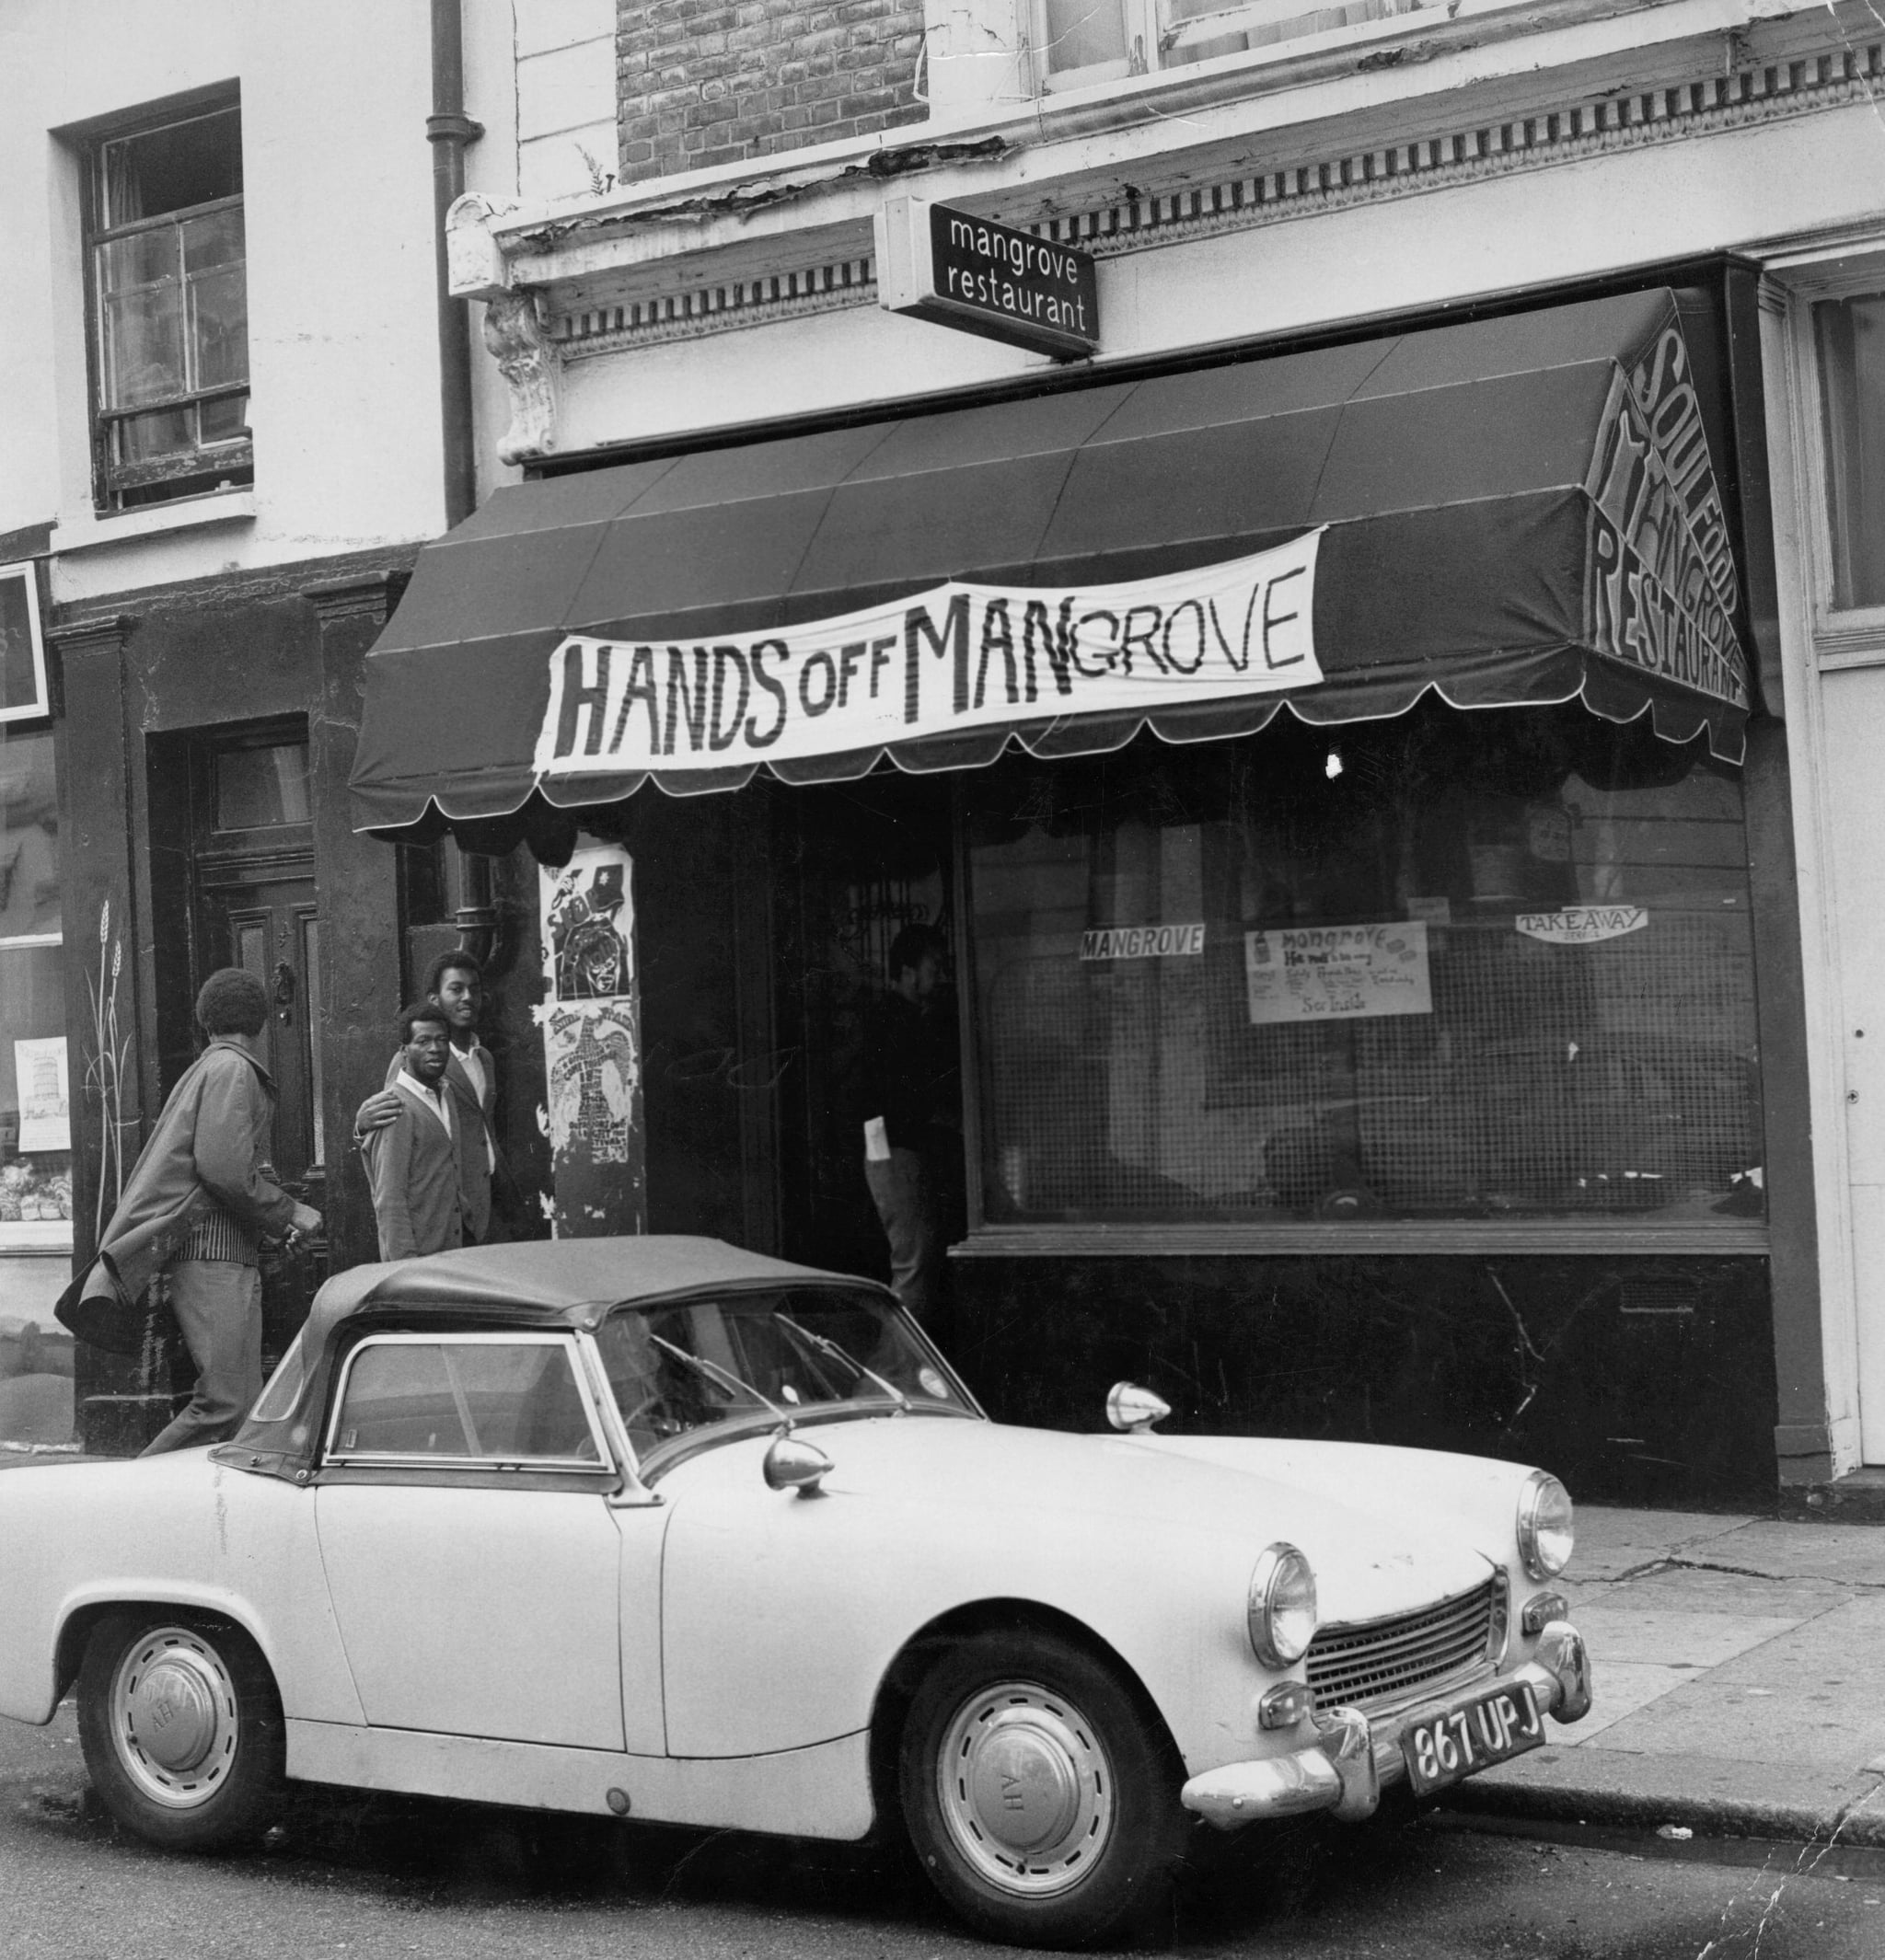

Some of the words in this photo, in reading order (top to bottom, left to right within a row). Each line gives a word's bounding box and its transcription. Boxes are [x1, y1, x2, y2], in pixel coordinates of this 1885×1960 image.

[950, 218, 1078, 283] mangrove
[947, 265, 1087, 331] restaurant
[1634, 328, 1712, 515] SOUL
[1688, 486, 1738, 616] FOOD
[553, 639, 790, 760] HANDS
[799, 635, 898, 718] OFF
[904, 565, 1307, 725] MANGROVE
[1081, 925, 1204, 958] MANGROVE
[1414, 1710, 1474, 1780] 867
[1476, 1686, 1540, 1751] UPJ
